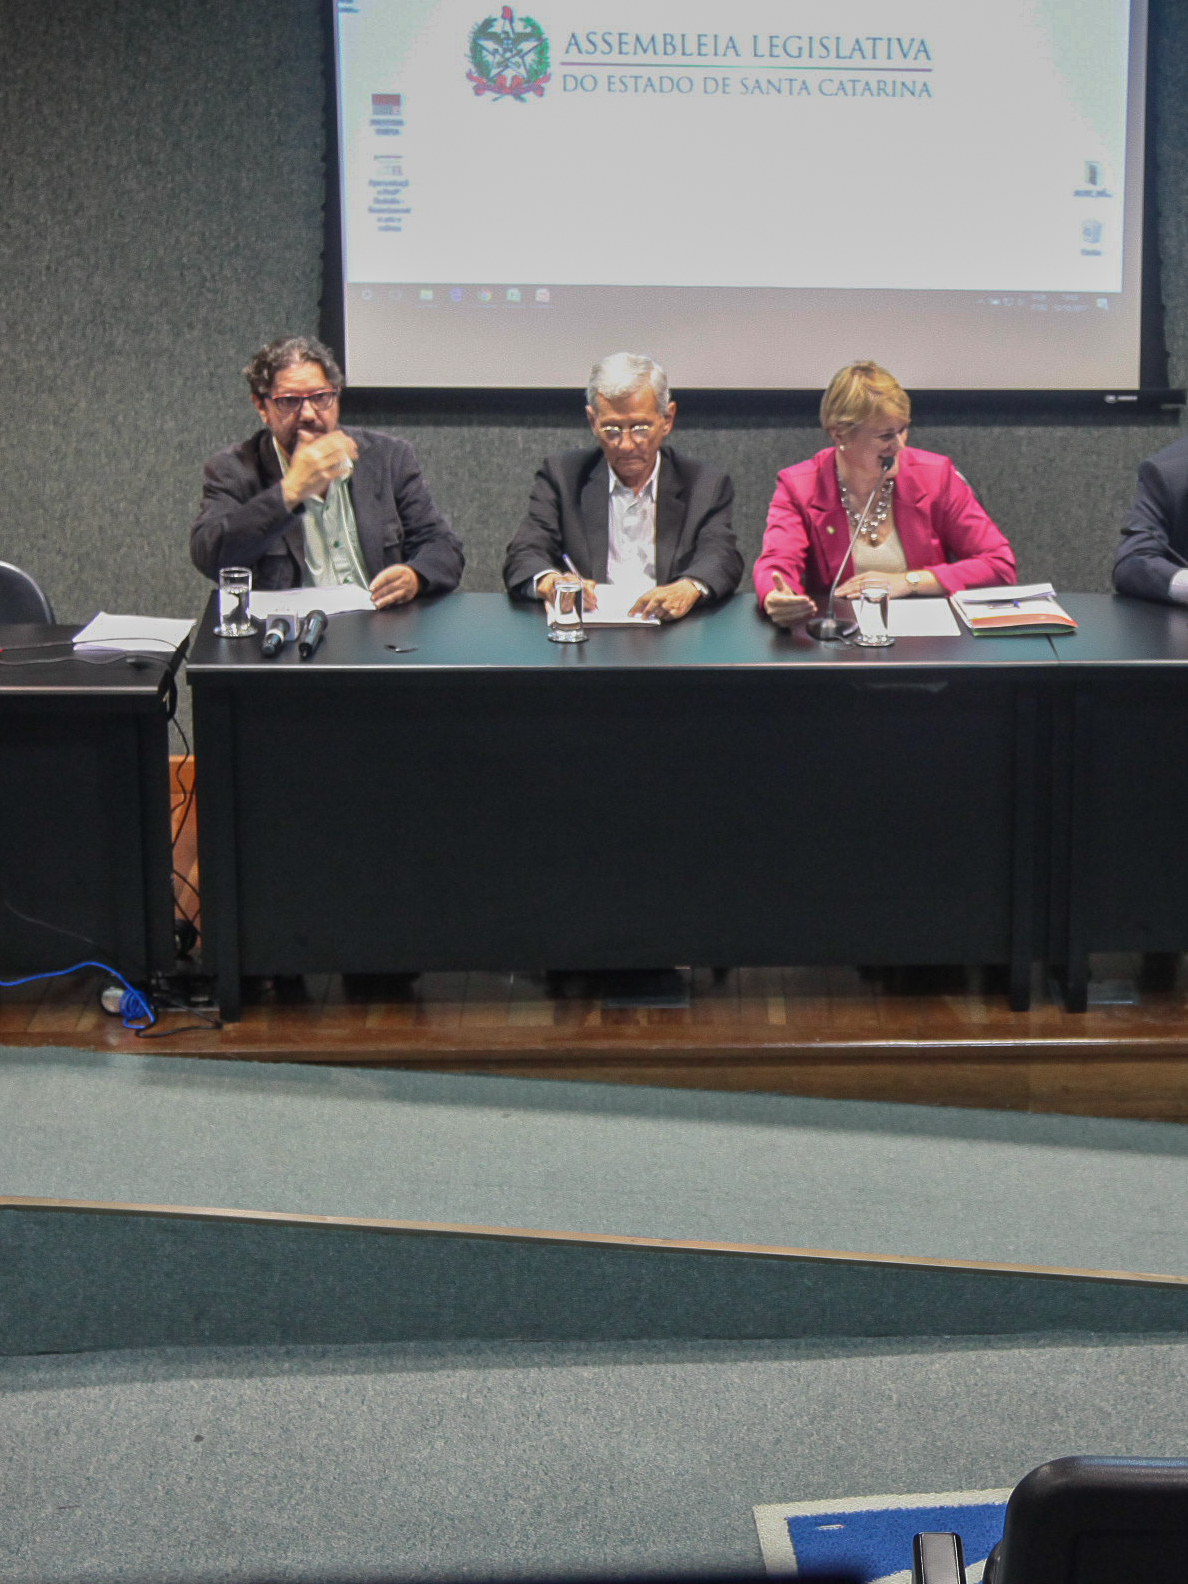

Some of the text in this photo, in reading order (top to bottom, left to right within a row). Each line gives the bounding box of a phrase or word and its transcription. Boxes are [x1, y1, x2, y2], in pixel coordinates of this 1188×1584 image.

[564, 31, 932, 61] ASSEMBLEIA LEGISLATIVA
[562, 74, 933, 98] DO ESTADO DE SANTA CATARINA
